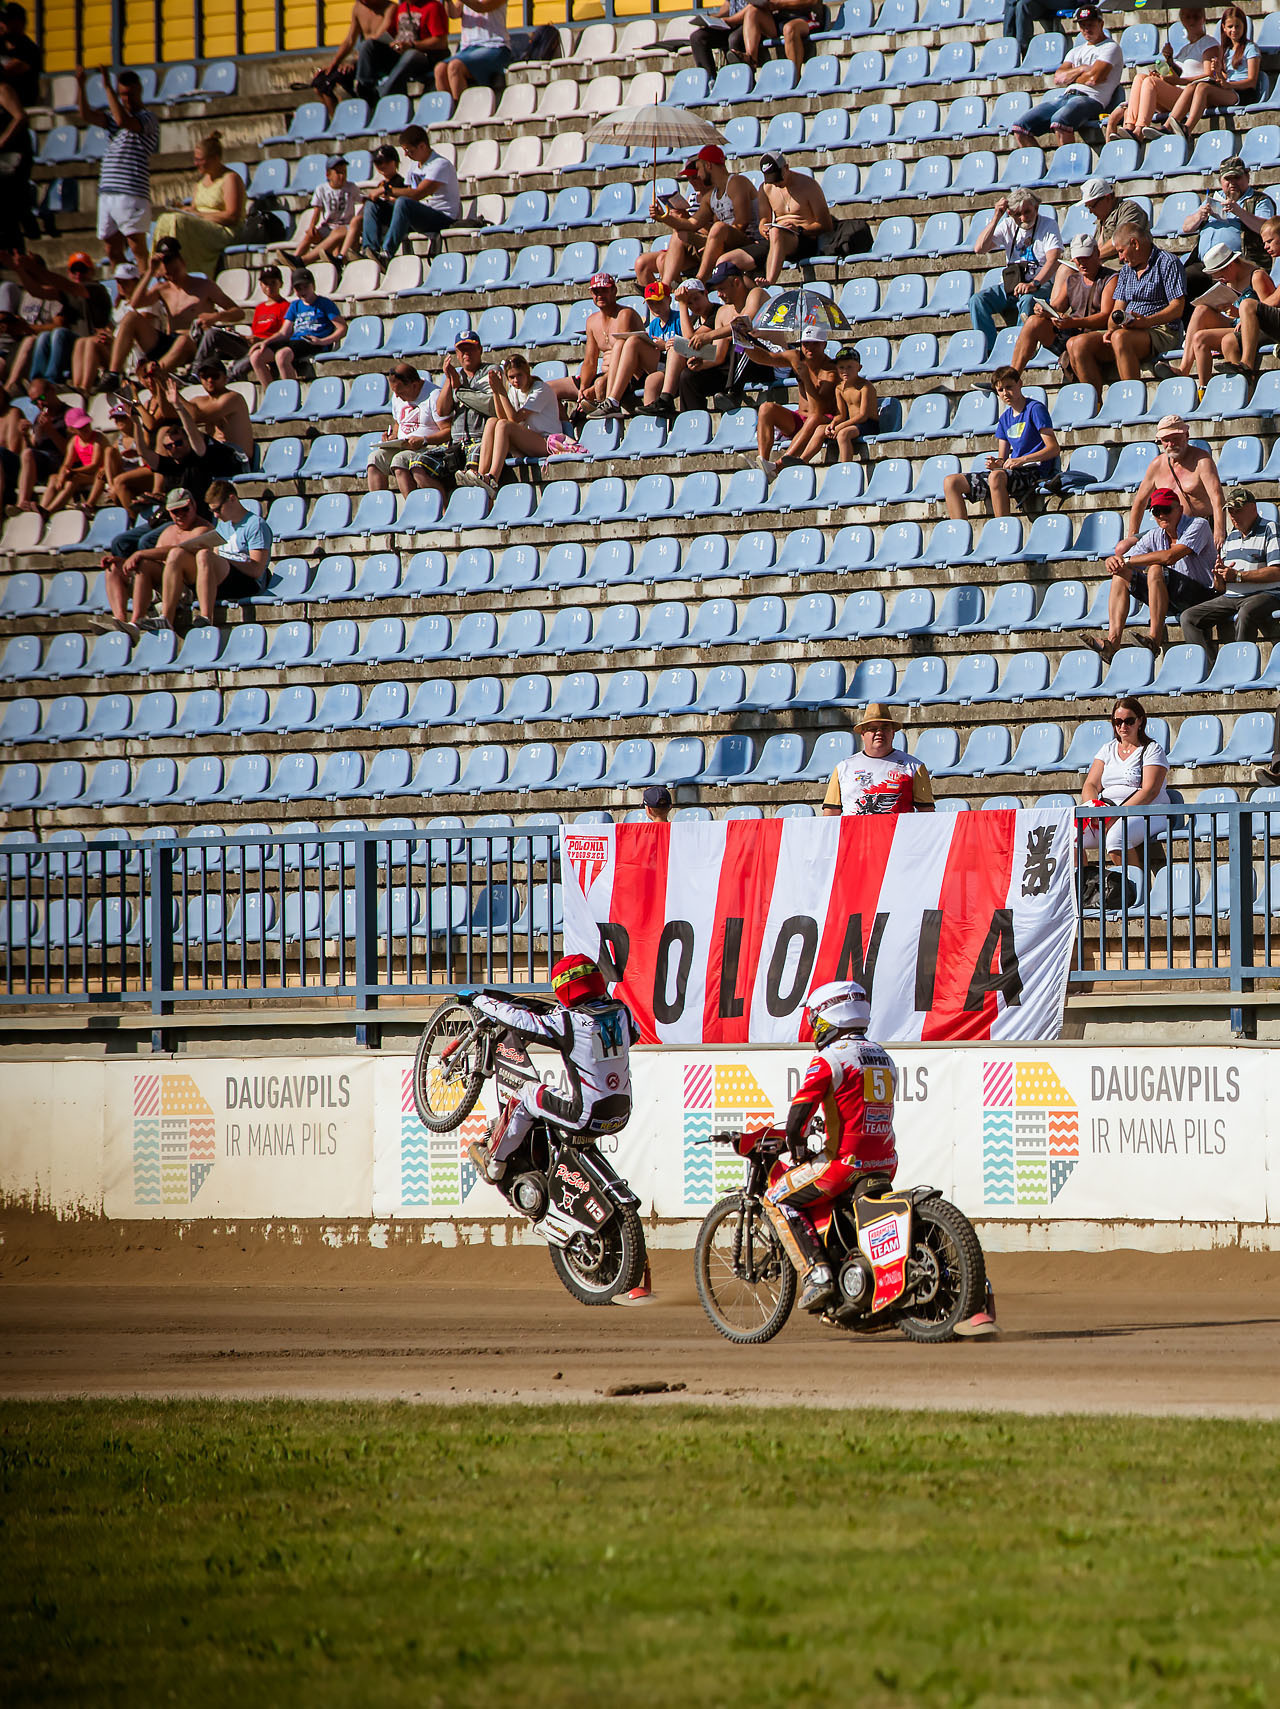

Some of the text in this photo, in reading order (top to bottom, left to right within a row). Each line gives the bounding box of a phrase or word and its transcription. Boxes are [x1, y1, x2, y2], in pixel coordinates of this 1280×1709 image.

[568, 841, 604, 851] POLONIA
[596, 909, 1023, 1024] POLONIA
[226, 1074, 350, 1109] DAUGAVPILS
[873, 1070, 886, 1100] 5
[1091, 1066, 1241, 1103] DAUGAVPILS
[225, 1122, 337, 1157] IR MANA PILS
[865, 1122, 890, 1134] TEAM
[1092, 1119, 1226, 1155] IR MANA PILS
[585, 1199, 604, 1221] 113
[872, 1240, 900, 1258] TEAM
